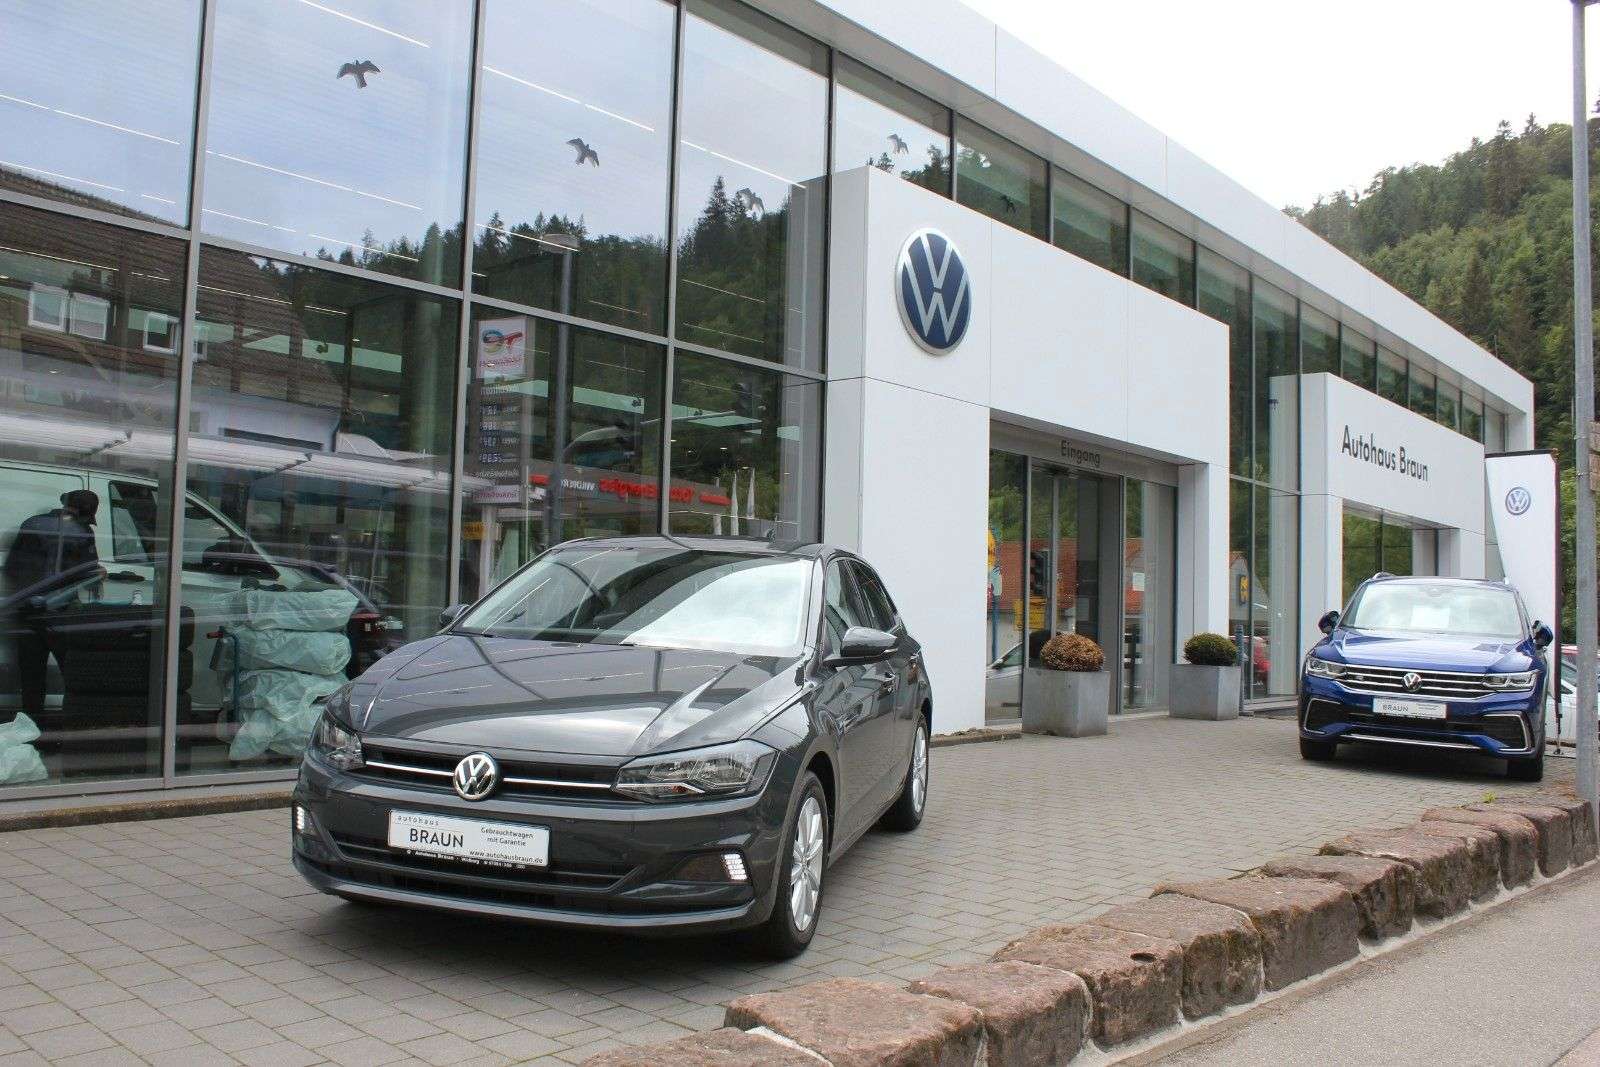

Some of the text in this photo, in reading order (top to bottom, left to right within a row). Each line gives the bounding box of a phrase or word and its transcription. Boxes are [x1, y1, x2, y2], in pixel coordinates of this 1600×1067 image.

[899, 229, 971, 351] VW
[1060, 439, 1101, 467] Eingang
[1341, 424, 1428, 481] Autohaus Braun
[1382, 704, 1409, 712] BRAUN
[454, 752, 497, 800] VW
[397, 815, 440, 826] autohaus
[409, 828, 464, 847] BRAUN
[480, 826, 535, 840] Gebrauchtwagen
[499, 837, 527, 847] Garantie
[469, 849, 544, 864] www.autohausbraun.de
